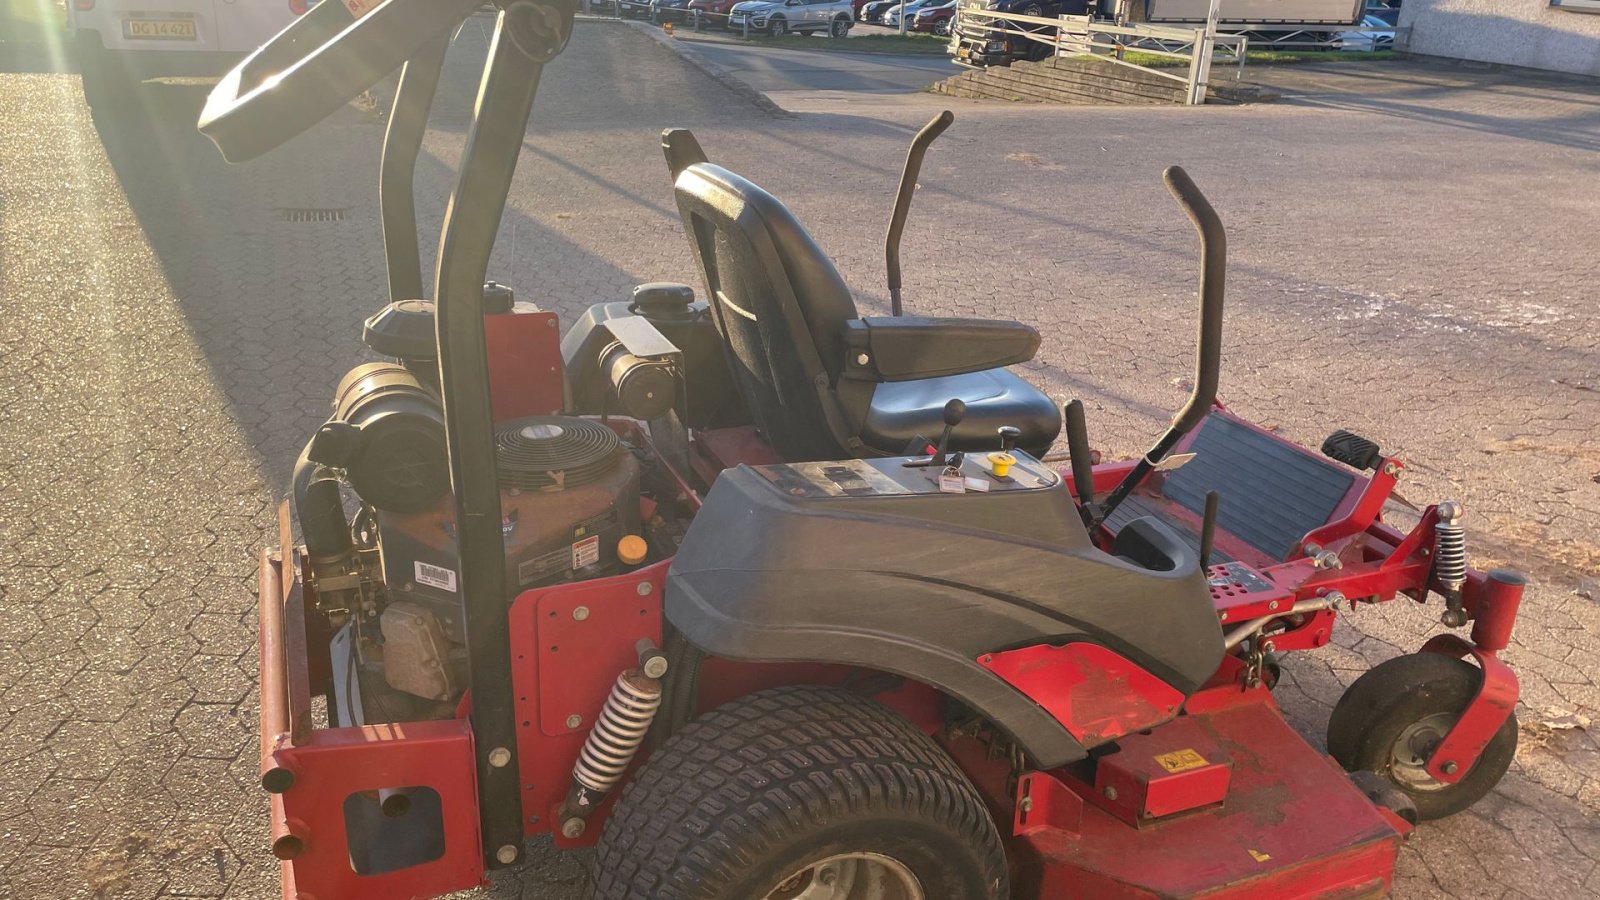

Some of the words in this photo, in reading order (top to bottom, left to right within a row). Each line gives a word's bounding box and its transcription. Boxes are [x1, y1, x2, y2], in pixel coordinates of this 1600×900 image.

[133, 23, 150, 34] DG
[154, 23, 168, 34] 14
[171, 23, 192, 34] 421
